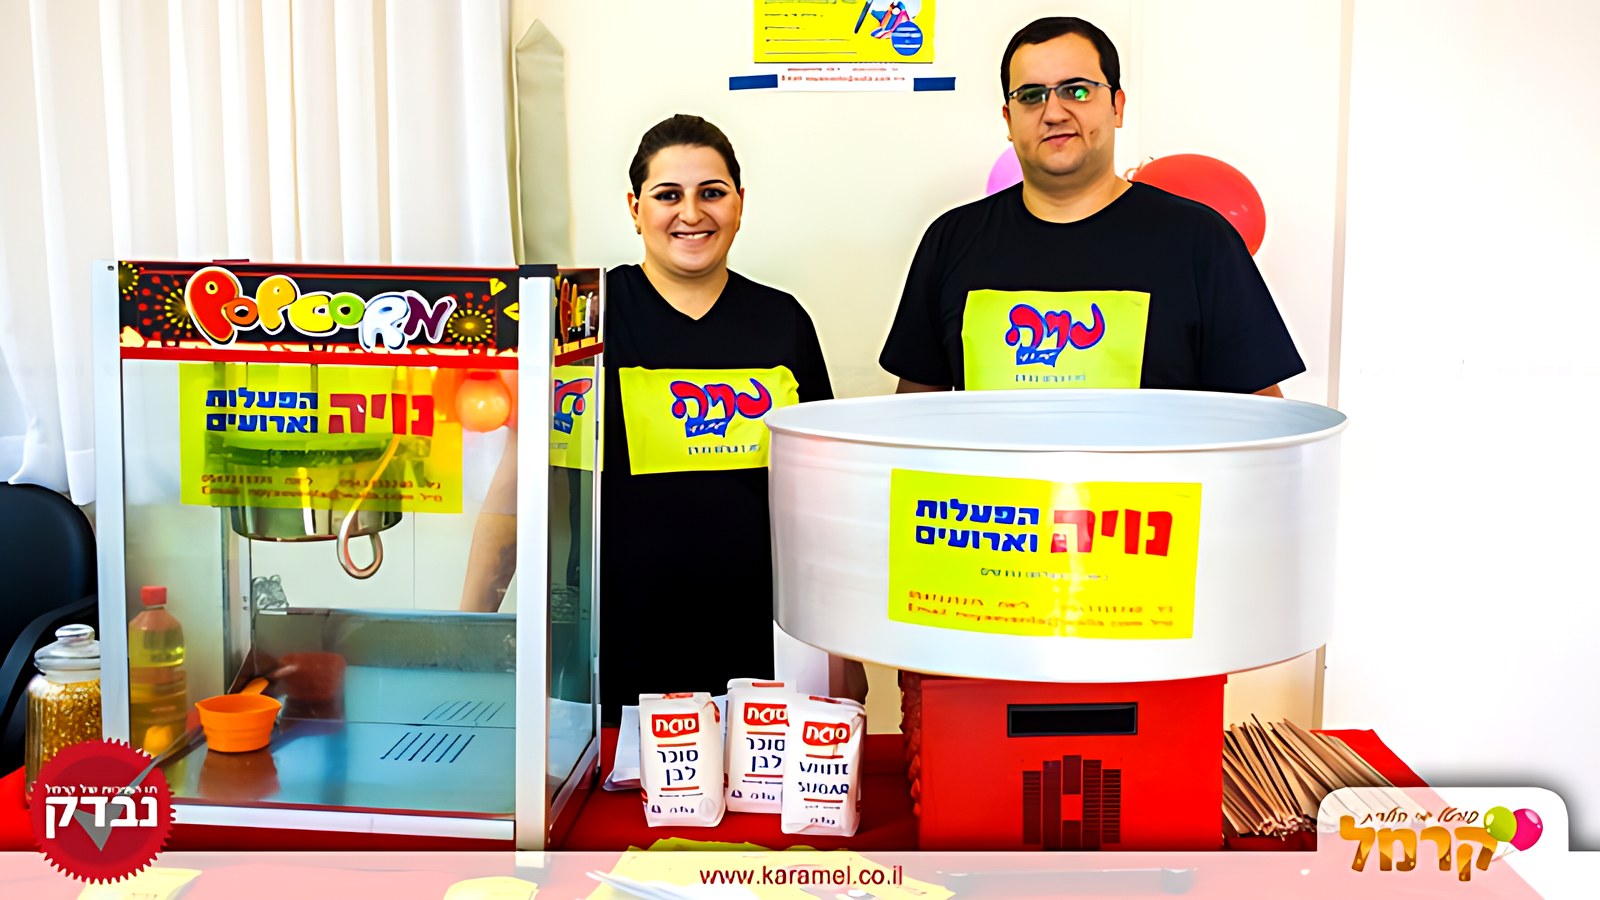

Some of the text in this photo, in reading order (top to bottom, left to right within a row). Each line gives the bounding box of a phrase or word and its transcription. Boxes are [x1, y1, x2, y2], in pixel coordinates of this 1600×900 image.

[185, 266, 458, 352] POPCORN
[205, 387, 318, 410] הפעלות
[206, 413, 318, 434] וארועים
[328, 393, 434, 437] נויה
[915, 498, 1039, 525] הפעלות
[915, 525, 1038, 553] וארועים
[1050, 509, 1173, 556] נויה
[653, 718, 696, 735] סוגת
[805, 726, 848, 743] סוגת
[746, 737, 785, 751] סוכר
[657, 749, 699, 763] סוכר
[751, 755, 782, 772] לבן
[665, 766, 697, 785] לבן
